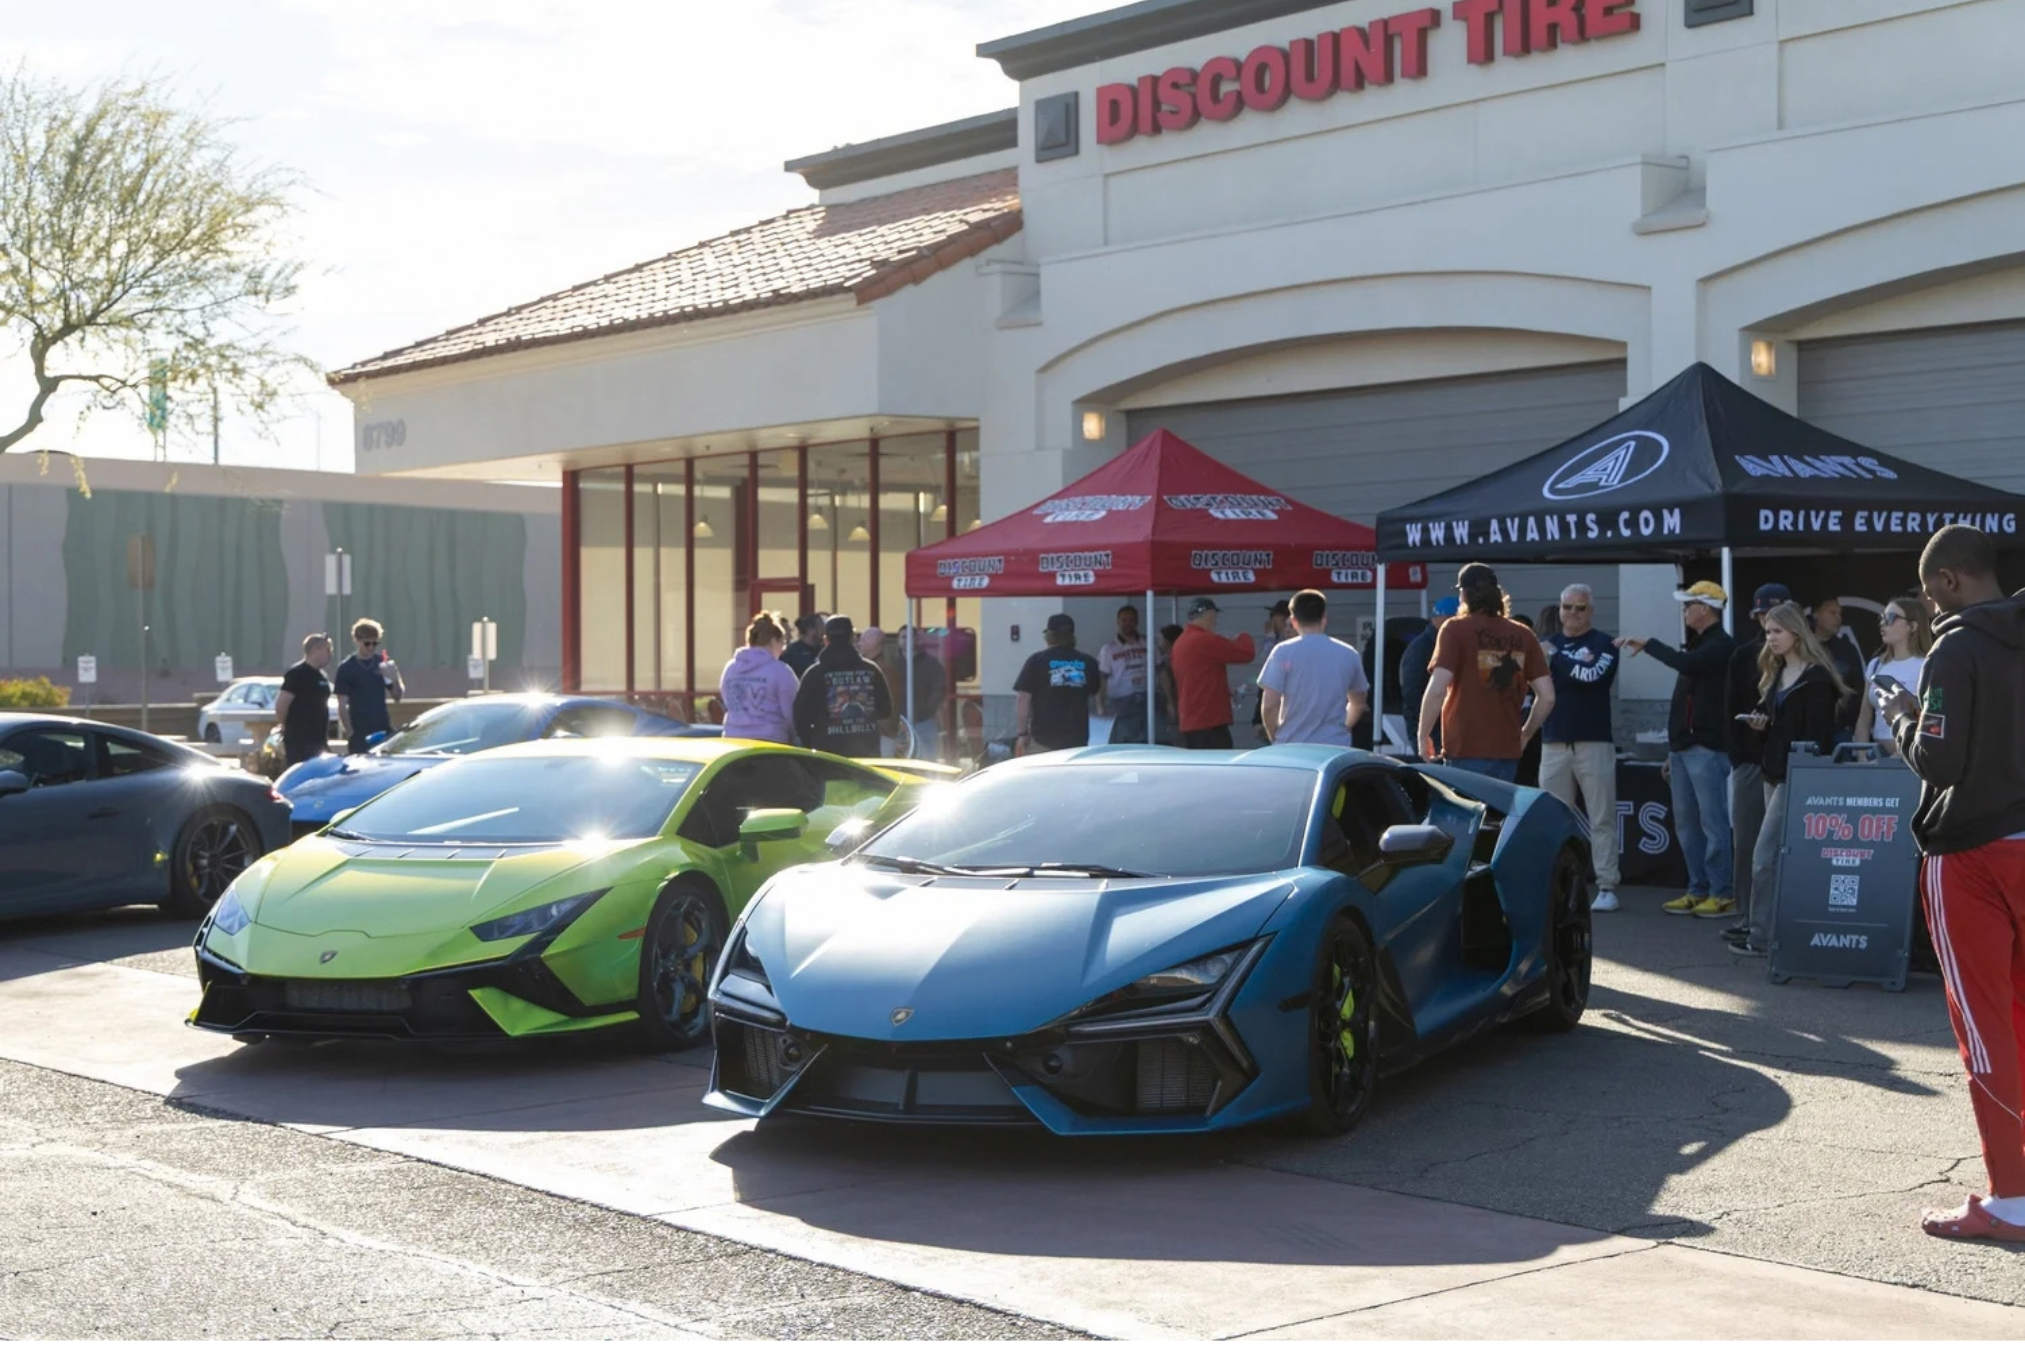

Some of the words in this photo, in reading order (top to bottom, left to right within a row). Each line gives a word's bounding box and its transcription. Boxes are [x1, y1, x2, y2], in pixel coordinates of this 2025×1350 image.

[1096, 8, 1441, 146] DISCOUNT
[1453, 0, 1641, 65] TIRE
[1735, 455, 1898, 479] AVANTS
[1405, 508, 1681, 547] WWW.AVANTS.COM
[1759, 509, 1843, 532] DRIVE
[938, 556, 1004, 576] DISCOUNT
[1039, 551, 1112, 571] DISCOUNT
[1191, 550, 1273, 569] DISCOUNT
[1313, 551, 1379, 568] DISCOU
[954, 576, 989, 588] TIRE
[1058, 571, 1093, 584] TIRE
[1213, 570, 1253, 582] TIRE
[1333, 570, 1370, 582] TIRE
[1805, 796, 1844, 806] AVANTS
[1846, 797, 1883, 808] MEMBERS
[1885, 798, 1899, 808] GET
[1804, 813, 1853, 840] 10%
[1858, 814, 1898, 841] OFF
[1810, 932, 1868, 949] AVANTS
